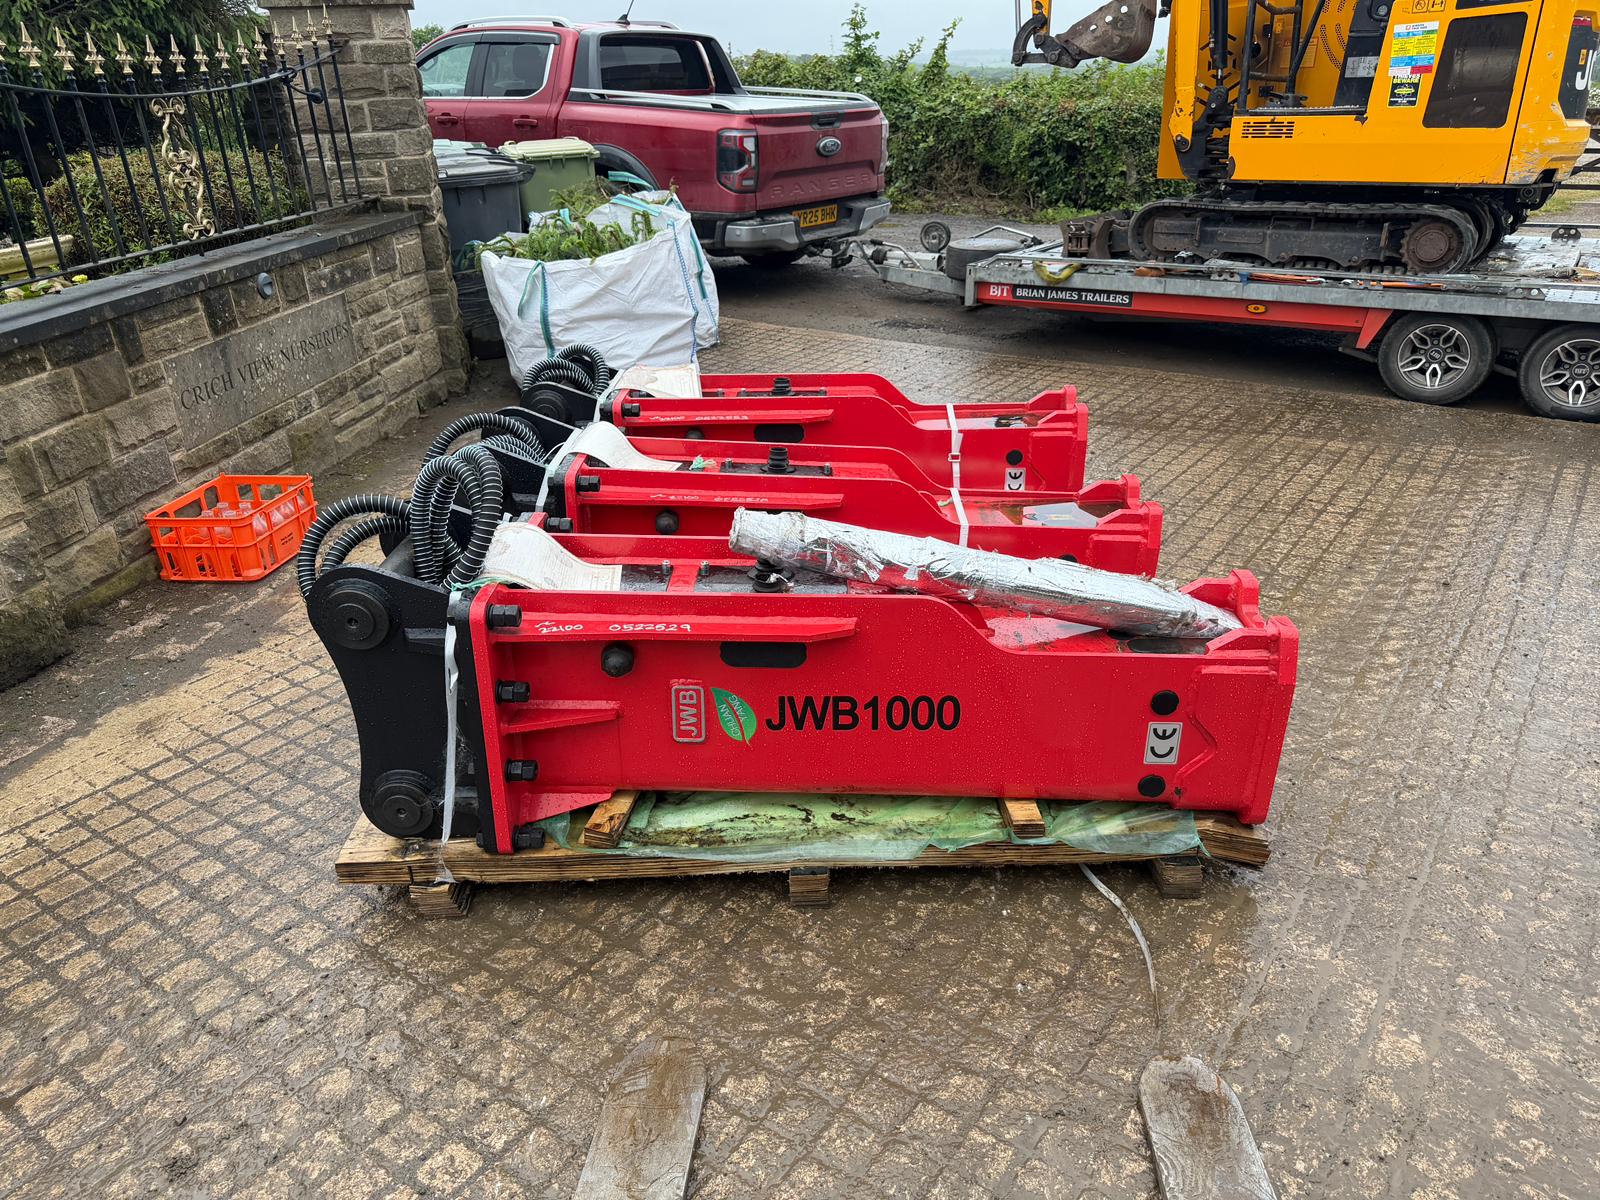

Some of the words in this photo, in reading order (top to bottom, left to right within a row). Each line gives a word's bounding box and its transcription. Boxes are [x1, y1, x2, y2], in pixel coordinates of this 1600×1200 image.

[772, 174, 872, 198] RANGER
[821, 205, 837, 222] BHK
[989, 285, 1010, 297] BJT
[1015, 287, 1046, 299] BRIAN
[1047, 288, 1079, 301] JAMES
[1081, 292, 1130, 305] TRAILERS
[180, 371, 235, 410] CRICH
[237, 354, 275, 384] VIEW
[280, 321, 350, 365] NURSERIES
[679, 690, 699, 738] JWB
[718, 703, 741, 737] CHUAN
[728, 694, 748, 722] YANG
[765, 694, 961, 731] JWB1000
